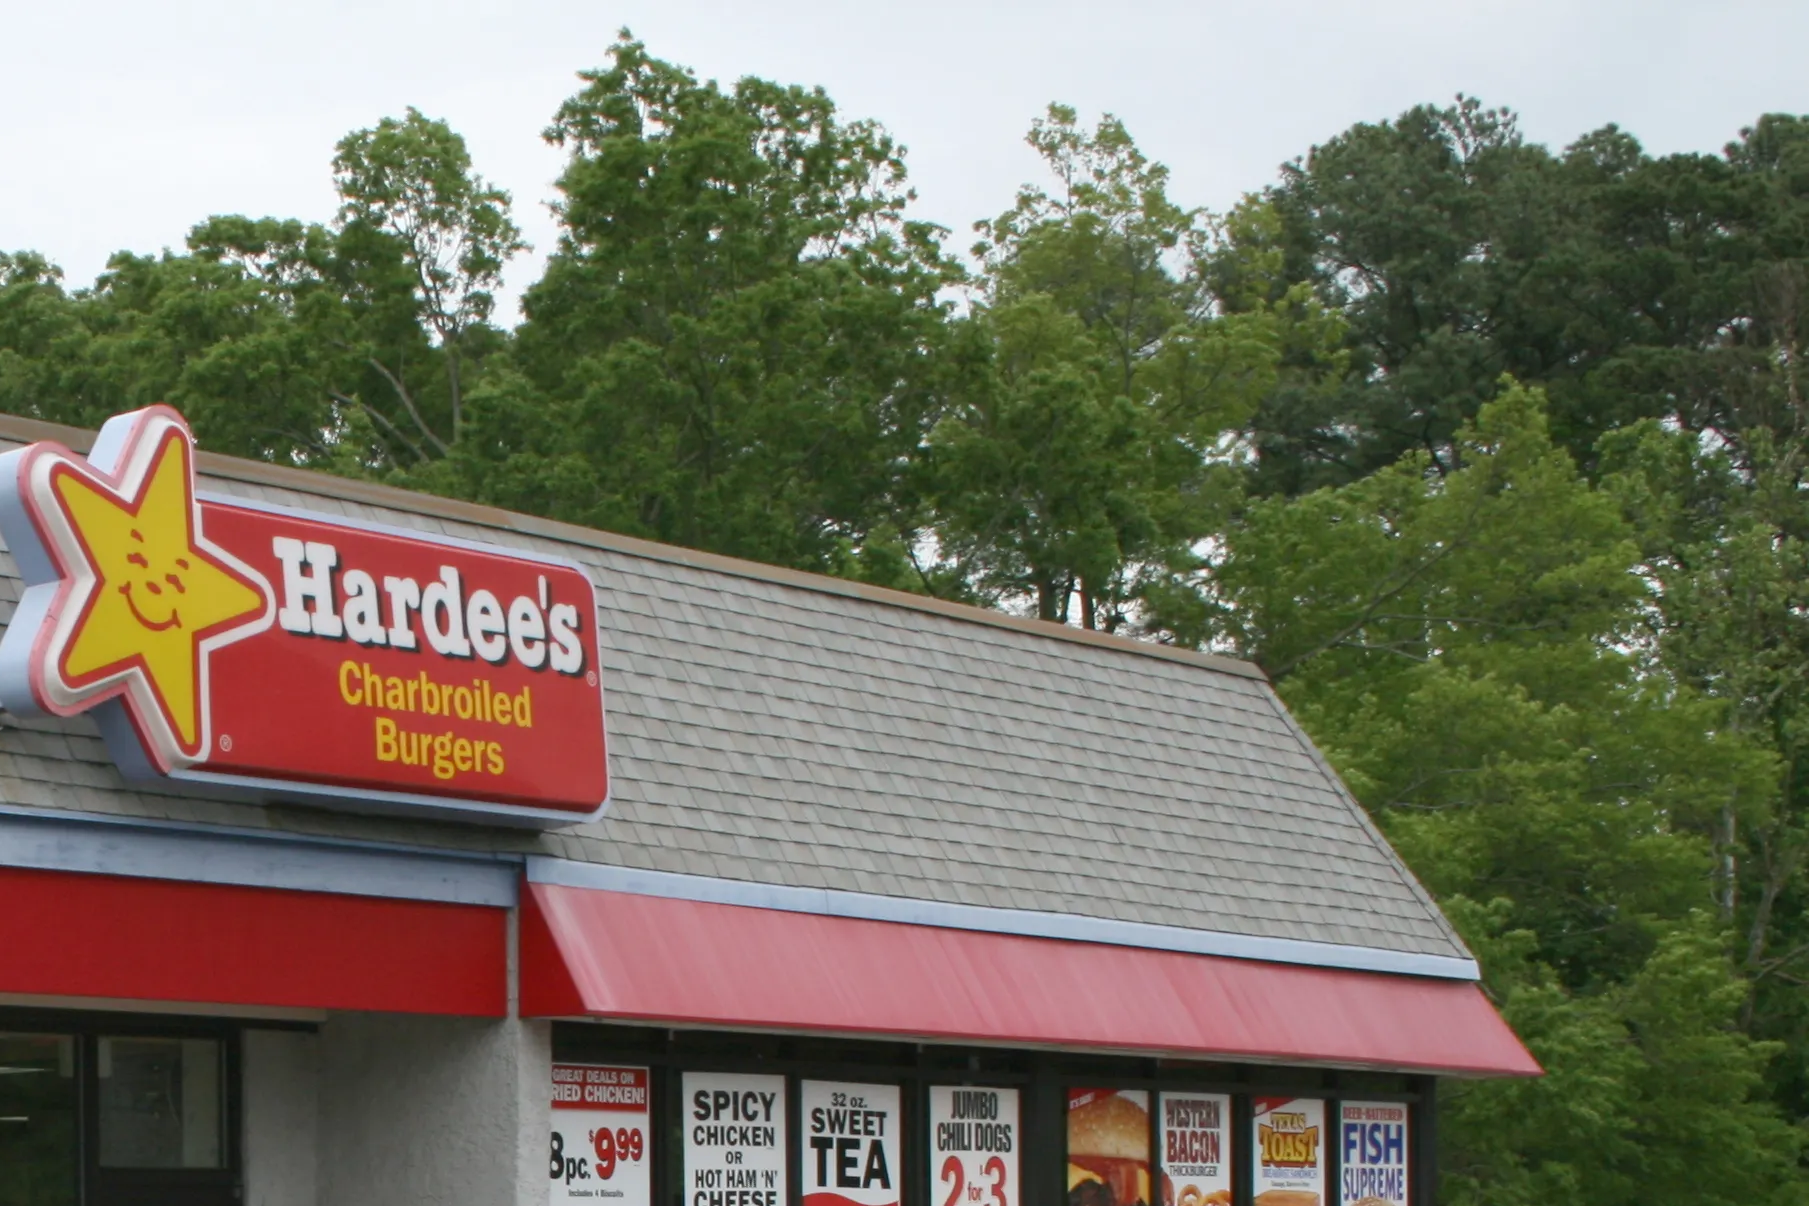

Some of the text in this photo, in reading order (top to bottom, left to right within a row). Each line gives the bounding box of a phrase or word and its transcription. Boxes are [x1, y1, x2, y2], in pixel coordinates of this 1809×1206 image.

[273, 536, 583, 674] Hardee's
[339, 660, 533, 728] Charbroiled
[376, 717, 505, 779] Burgers
[587, 1070, 617, 1084] DEALS
[552, 1084, 645, 1104] RIED CHICKEN!
[693, 1090, 776, 1122] SPICY
[832, 1093, 867, 1108] 32 oz.
[951, 1091, 998, 1121] JUMBO
[811, 1108, 887, 1136] SWEET
[1165, 1099, 1220, 1128] WESTERN
[693, 1125, 775, 1147] CHICKEN
[937, 1122, 1012, 1153] CHILI DOGS
[1166, 1130, 1220, 1164] BACON
[1259, 1127, 1317, 1162] TOAST
[1343, 1123, 1403, 1164] FISH
[725, 1151, 743, 1164] OR
[810, 1136, 891, 1189] TEA
[695, 1169, 722, 1188] HOT
[726, 1169, 757, 1188] HAM
[967, 1182, 983, 1201] for
[1343, 1168, 1403, 1201] SUPREME
